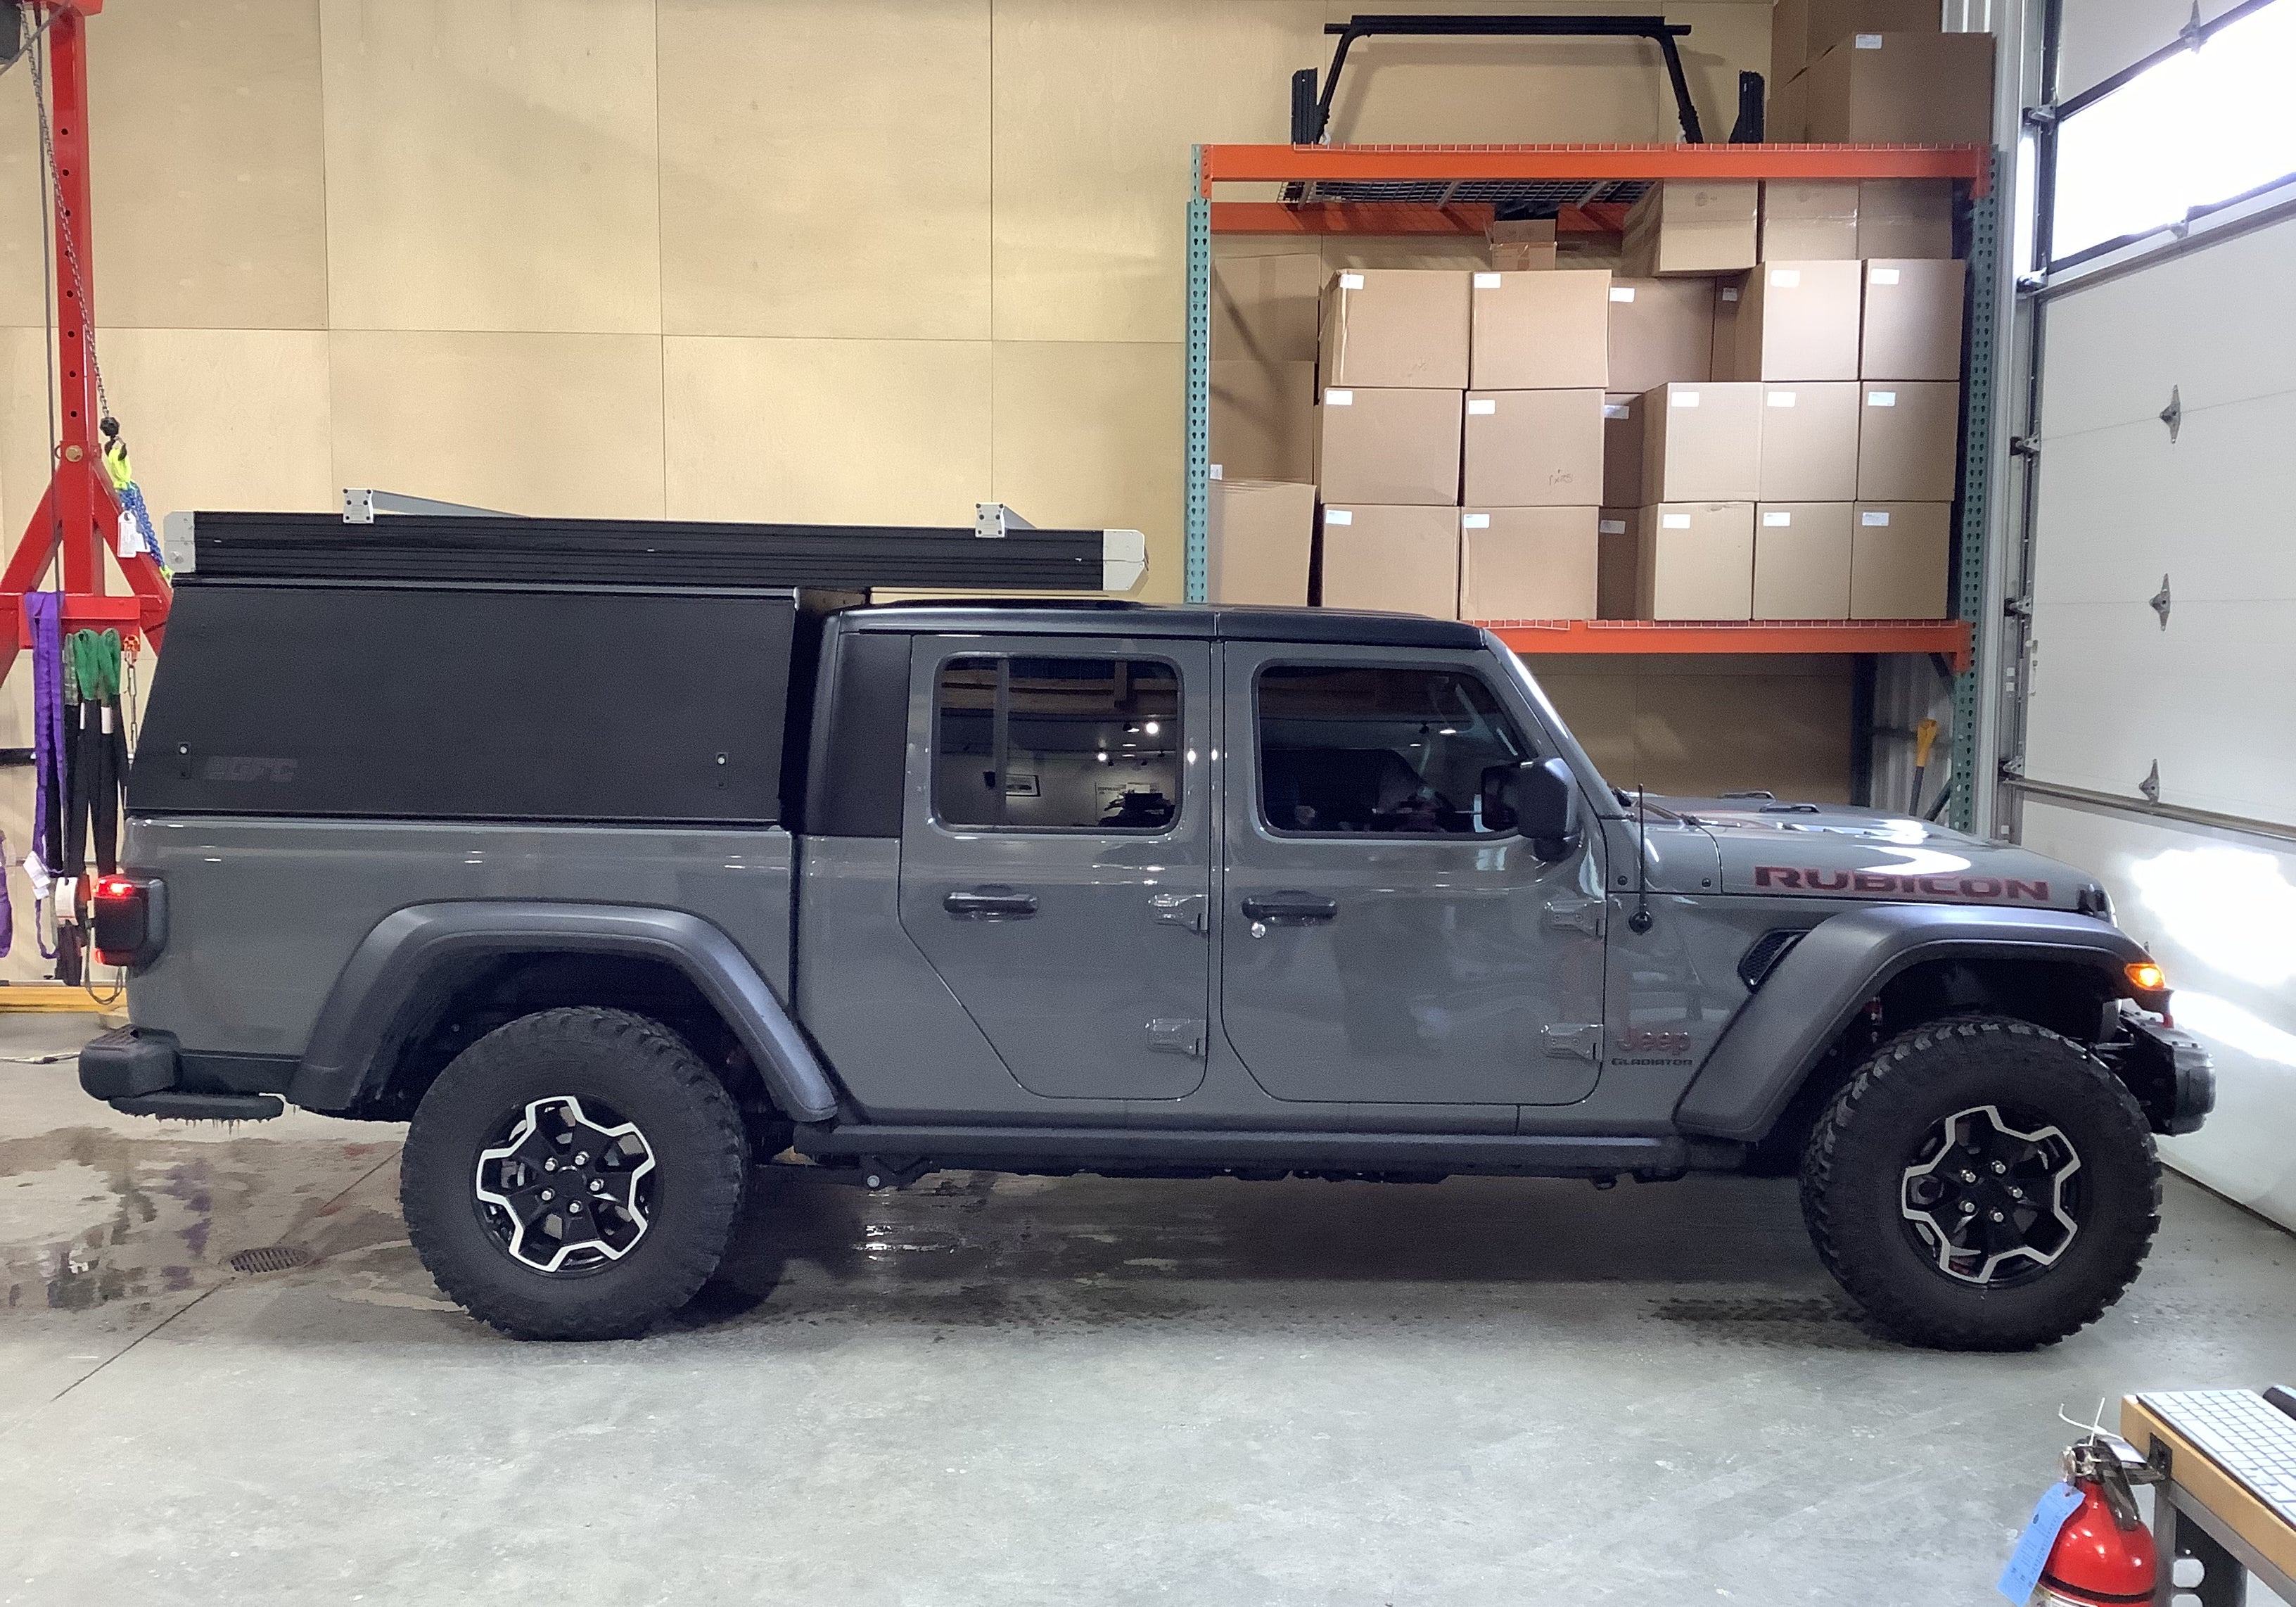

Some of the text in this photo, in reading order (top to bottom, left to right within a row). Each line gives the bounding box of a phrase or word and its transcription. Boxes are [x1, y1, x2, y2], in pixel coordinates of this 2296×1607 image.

[1755, 866, 2049, 901] RUBICON
[1616, 1027, 1691, 1056] Jeep
[1611, 1057, 1693, 1066] GLADIATOR
